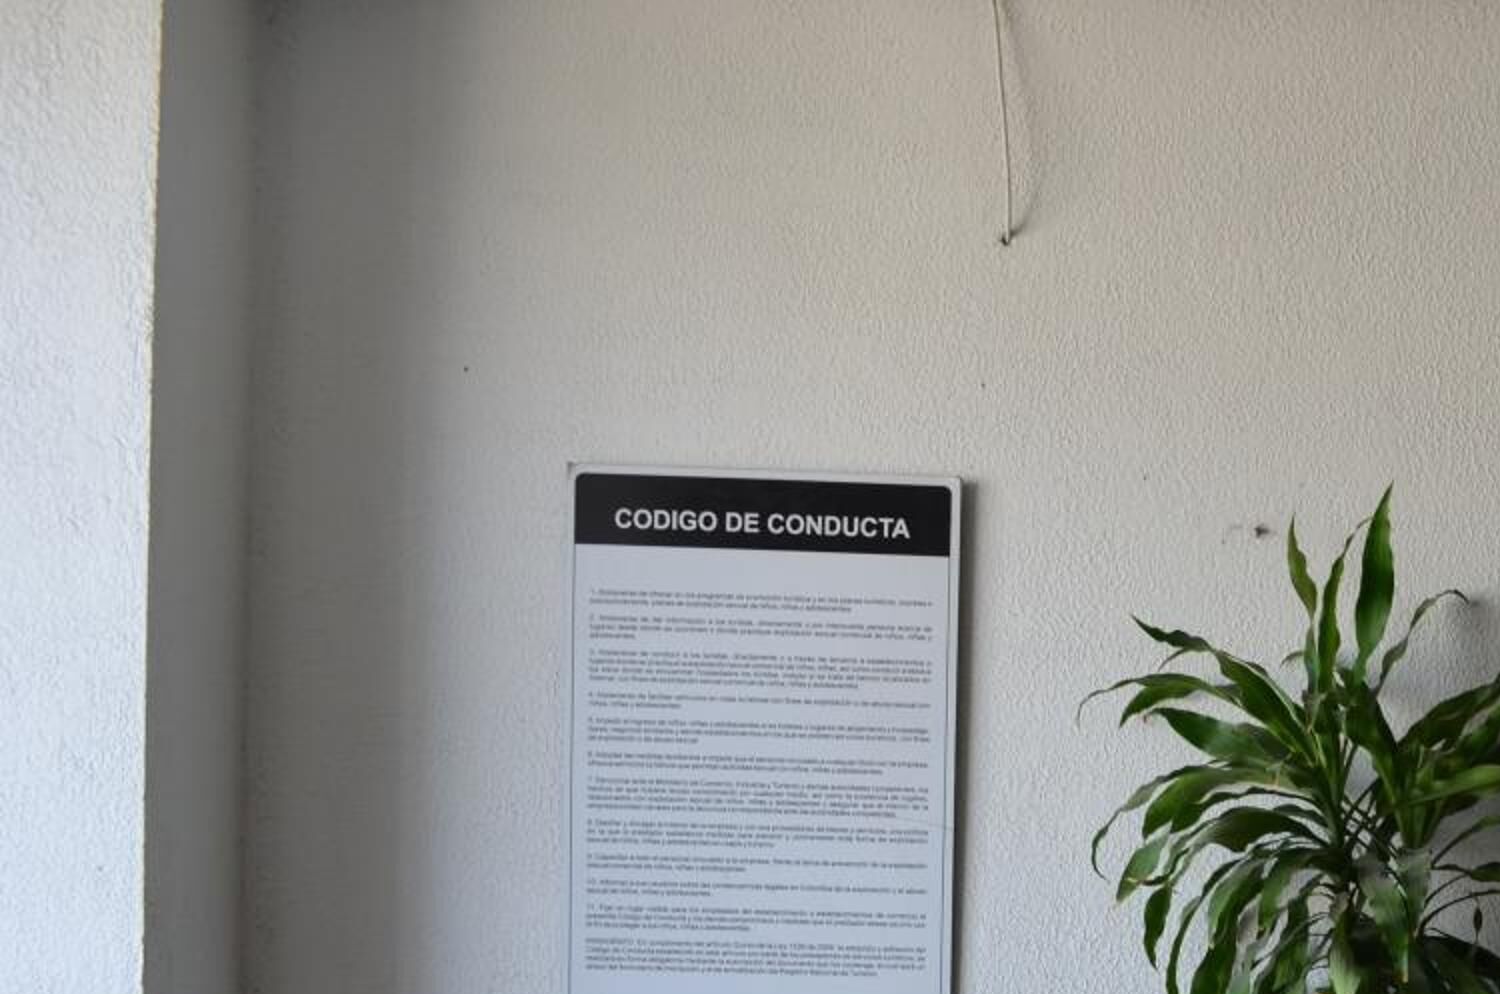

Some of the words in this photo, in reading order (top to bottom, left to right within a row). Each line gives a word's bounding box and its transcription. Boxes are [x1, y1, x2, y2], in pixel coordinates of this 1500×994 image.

[614, 507, 718, 533] CODIGO
[725, 511, 761, 534] DE
[767, 513, 911, 539] CONDUCTA
